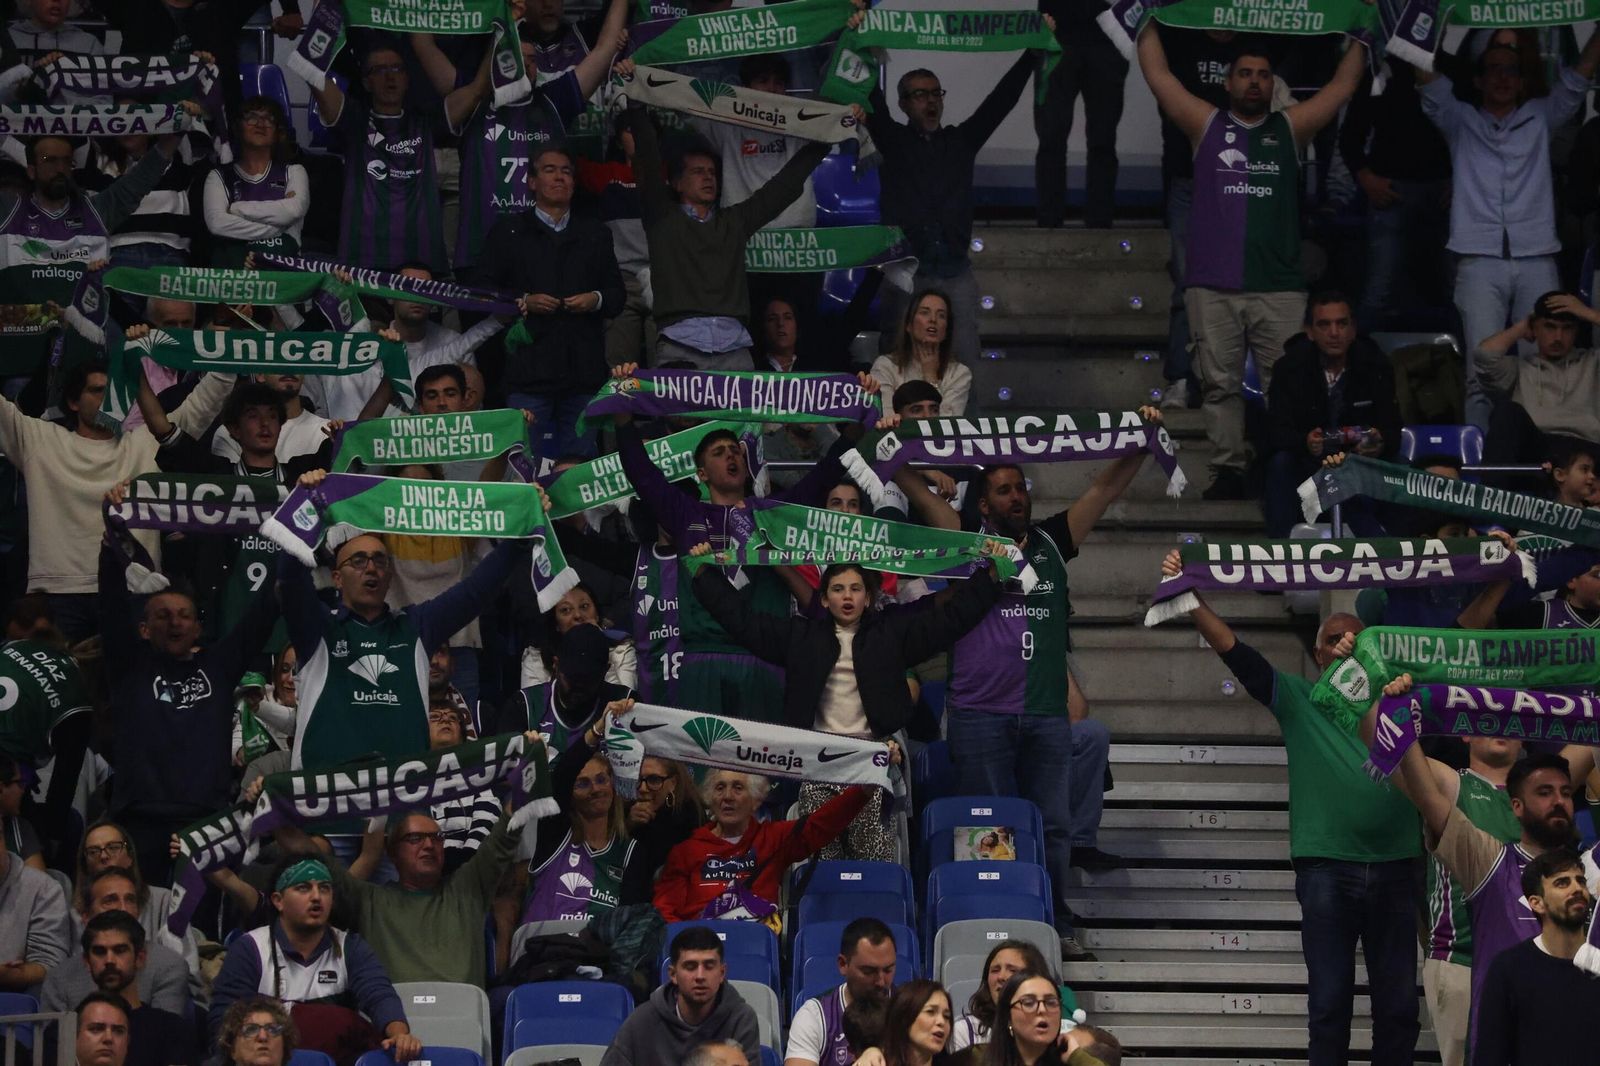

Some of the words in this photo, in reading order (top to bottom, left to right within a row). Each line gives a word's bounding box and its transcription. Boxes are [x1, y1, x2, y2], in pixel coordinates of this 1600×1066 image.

[370, 7, 483, 30] BALONCESTO
[698, 9, 779, 36] UNICAJA
[1213, 7, 1325, 31] BALONCESTO
[1470, 2, 1586, 23] BALONCESTO
[686, 26, 798, 56] BALONCESTO
[733, 101, 787, 126] Unicaja
[507, 129, 551, 143] Unicaja
[1245, 160, 1280, 176] Unicaja
[1223, 182, 1273, 198] málaga
[31, 266, 83, 282] málaga
[159, 273, 278, 301] BALONCESTO
[192, 331, 380, 370] Unicaja
[653, 375, 743, 413] UNICAJA
[751, 374, 874, 416] BALONCESTO
[390, 414, 474, 437] UNICAJA
[917, 410, 1147, 457] UNICAJA
[373, 432, 494, 459] BALONCESTO
[401, 484, 487, 509] UNICAJA
[1405, 471, 1477, 508] UNICAJA
[1481, 486, 1583, 531] BALONCESTO
[384, 506, 506, 532] BALONCESTO
[806, 509, 889, 544] UNICAJA
[1207, 539, 1455, 585] UNICAJA
[246, 561, 268, 592] 9
[1000, 603, 1050, 620] málaga
[1021, 631, 1034, 661] 9
[1379, 632, 1481, 667] UNICAJA
[1481, 632, 1596, 668] CAMPEÓN
[1447, 667, 1468, 679] COPA
[1469, 668, 1484, 680] DEL
[1485, 668, 1501, 680] REY
[353, 688, 399, 704] Unicaja
[736, 744, 803, 771] Unicaja
[1188, 749, 1208, 760] 17
[1198, 814, 1218, 825] 16
[1212, 874, 1232, 885] 15
[1220, 935, 1240, 946] 14
[1231, 998, 1252, 1010] 13
